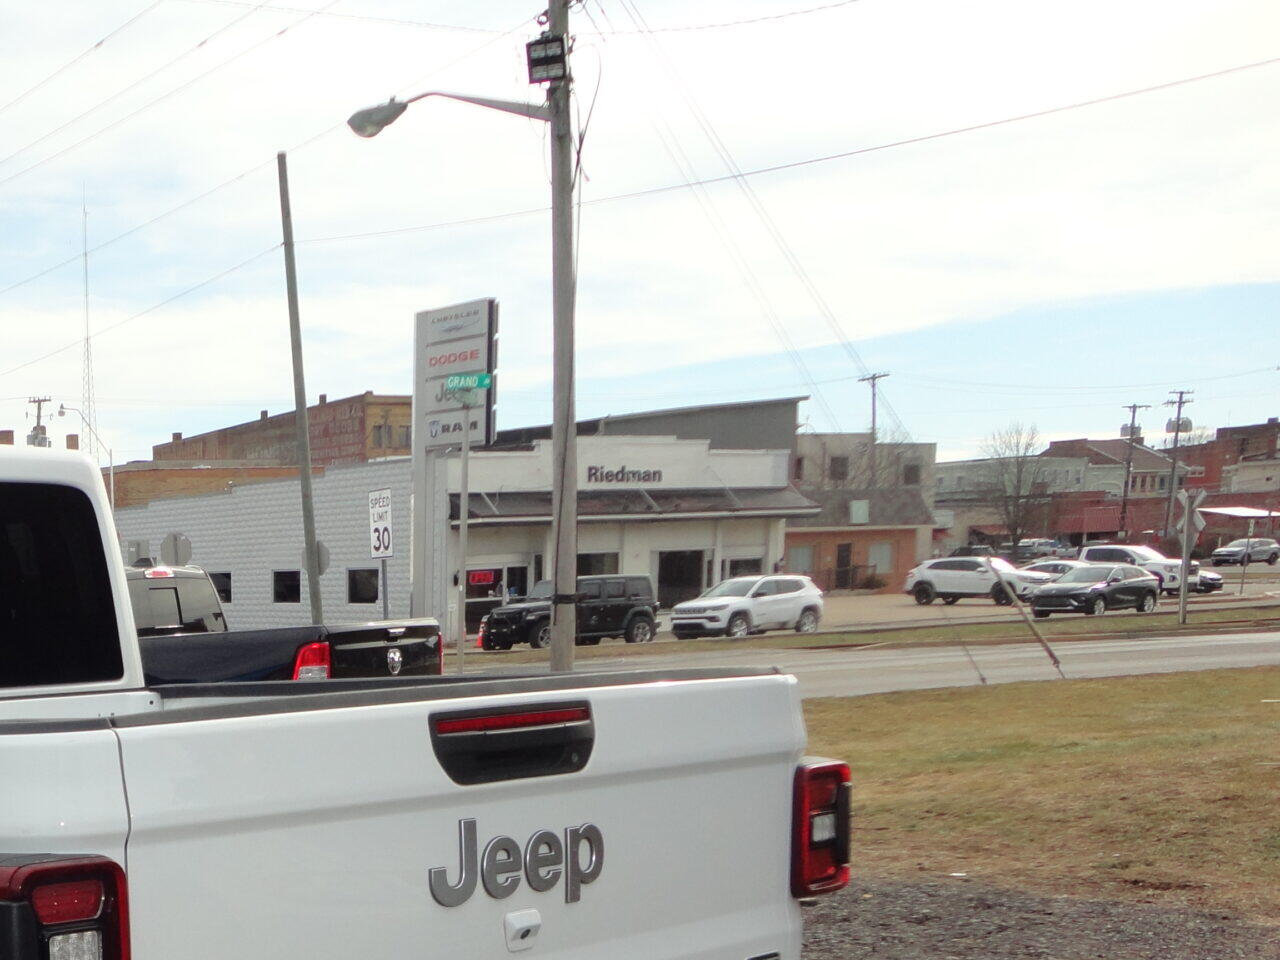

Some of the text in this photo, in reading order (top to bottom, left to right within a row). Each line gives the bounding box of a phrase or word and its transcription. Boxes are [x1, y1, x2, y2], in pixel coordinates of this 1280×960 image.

[429, 349, 481, 368] DODGE
[447, 375, 478, 388] GRAND
[587, 465, 663, 483] Riedman
[370, 496, 391, 509] SPEED
[372, 511, 388, 523] LIMIT
[373, 526, 391, 553] 30
[428, 817, 605, 908] Jeep
